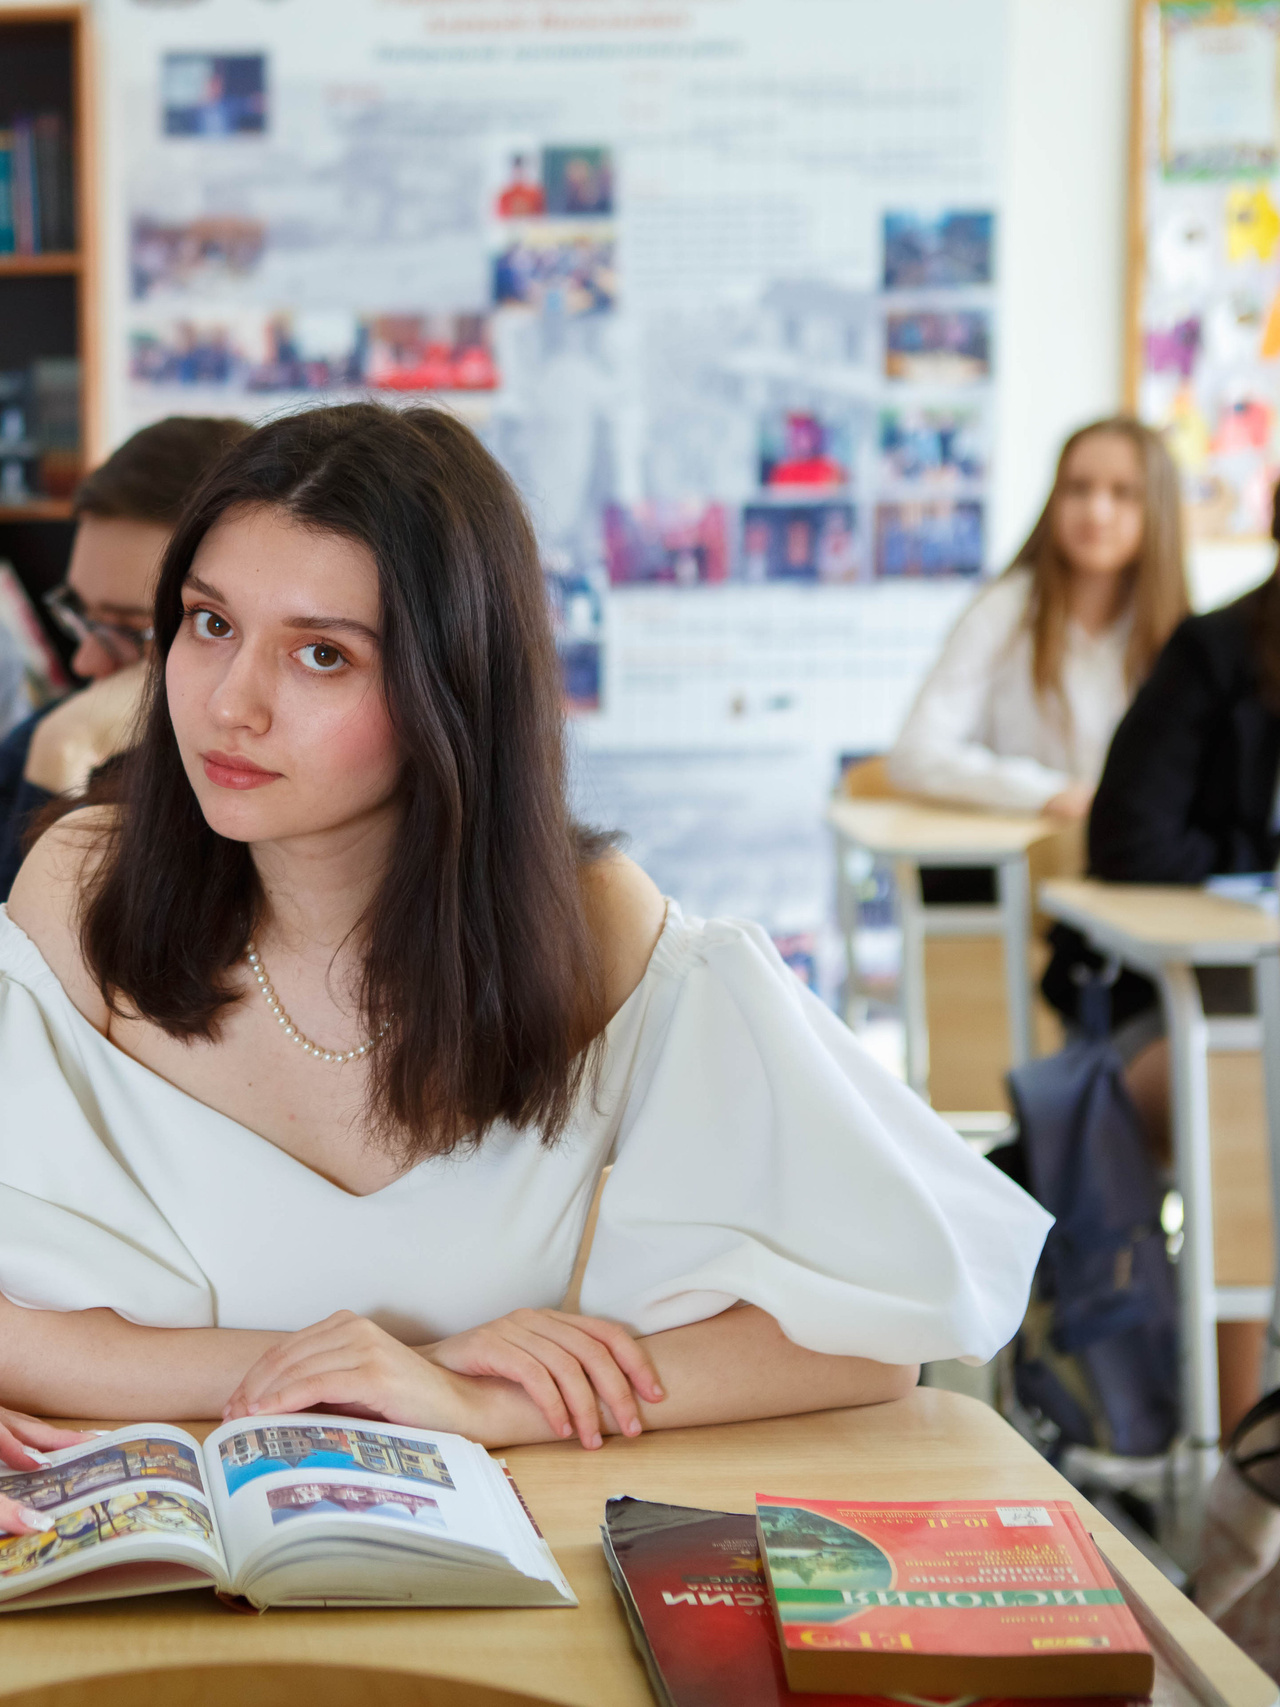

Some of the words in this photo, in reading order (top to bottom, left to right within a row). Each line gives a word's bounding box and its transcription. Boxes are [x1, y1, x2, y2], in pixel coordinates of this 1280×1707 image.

[927, 1518, 989, 1528] 10-11
[908, 1573, 1084, 1585] Тематические
[661, 1591, 773, 1606] СИИ
[841, 1588, 1088, 1609] ИСТОРИЯ
